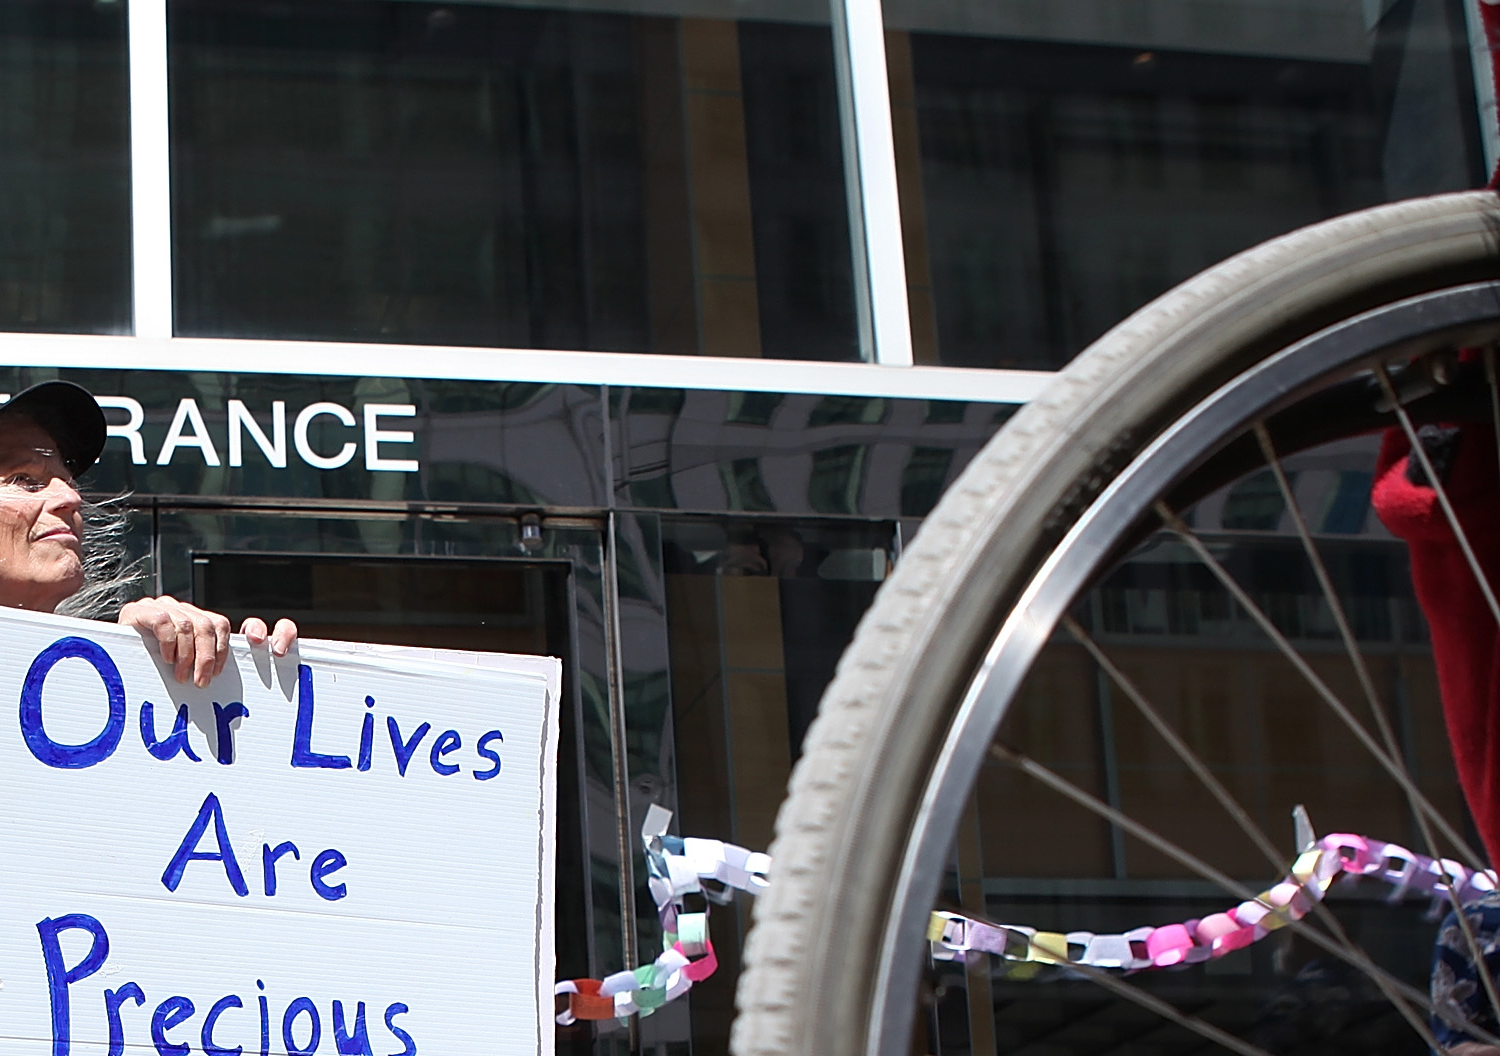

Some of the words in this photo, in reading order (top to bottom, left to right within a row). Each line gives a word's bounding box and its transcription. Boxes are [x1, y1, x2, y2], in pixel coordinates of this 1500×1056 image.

[19, 636, 250, 769] Our
[290, 664, 504, 781] Lives
[161, 791, 348, 901] Are
